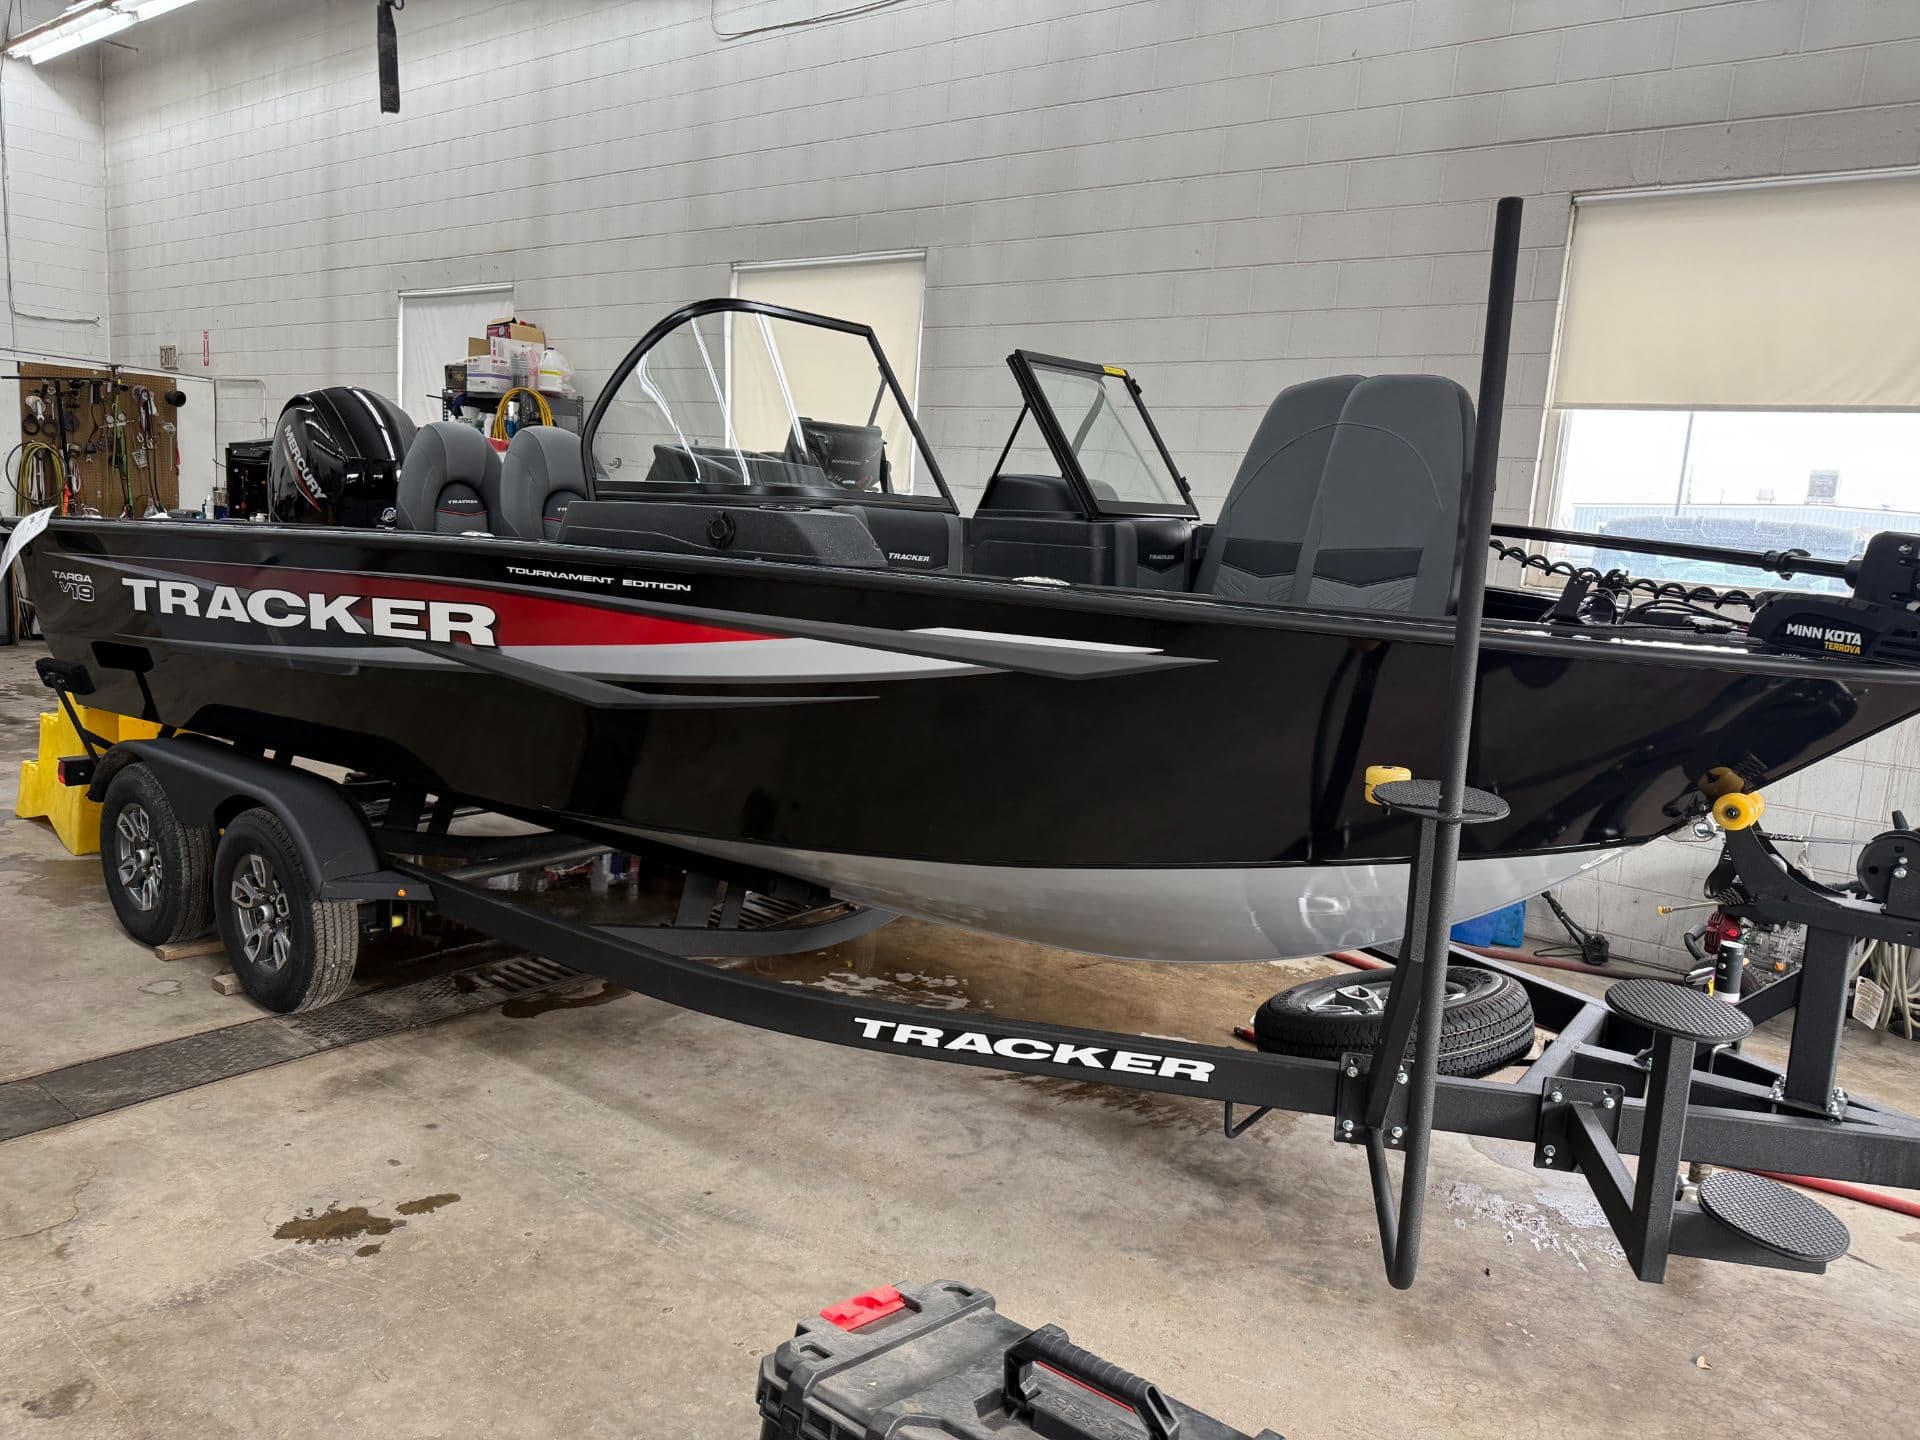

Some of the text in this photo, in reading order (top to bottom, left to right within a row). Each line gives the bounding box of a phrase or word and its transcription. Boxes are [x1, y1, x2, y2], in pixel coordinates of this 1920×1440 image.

[284, 424, 328, 499] MERCURY
[888, 552, 930, 562] TRACKER
[52, 570, 93, 583] TARGA
[506, 566, 692, 592] TOURNAMENT EDITION
[58, 581, 95, 602] V19
[121, 577, 497, 647] TRACKER
[1786, 623, 1862, 646] MINN KOTA
[1823, 641, 1861, 655] TERROVA
[854, 1017, 1216, 1083] TRACKER
